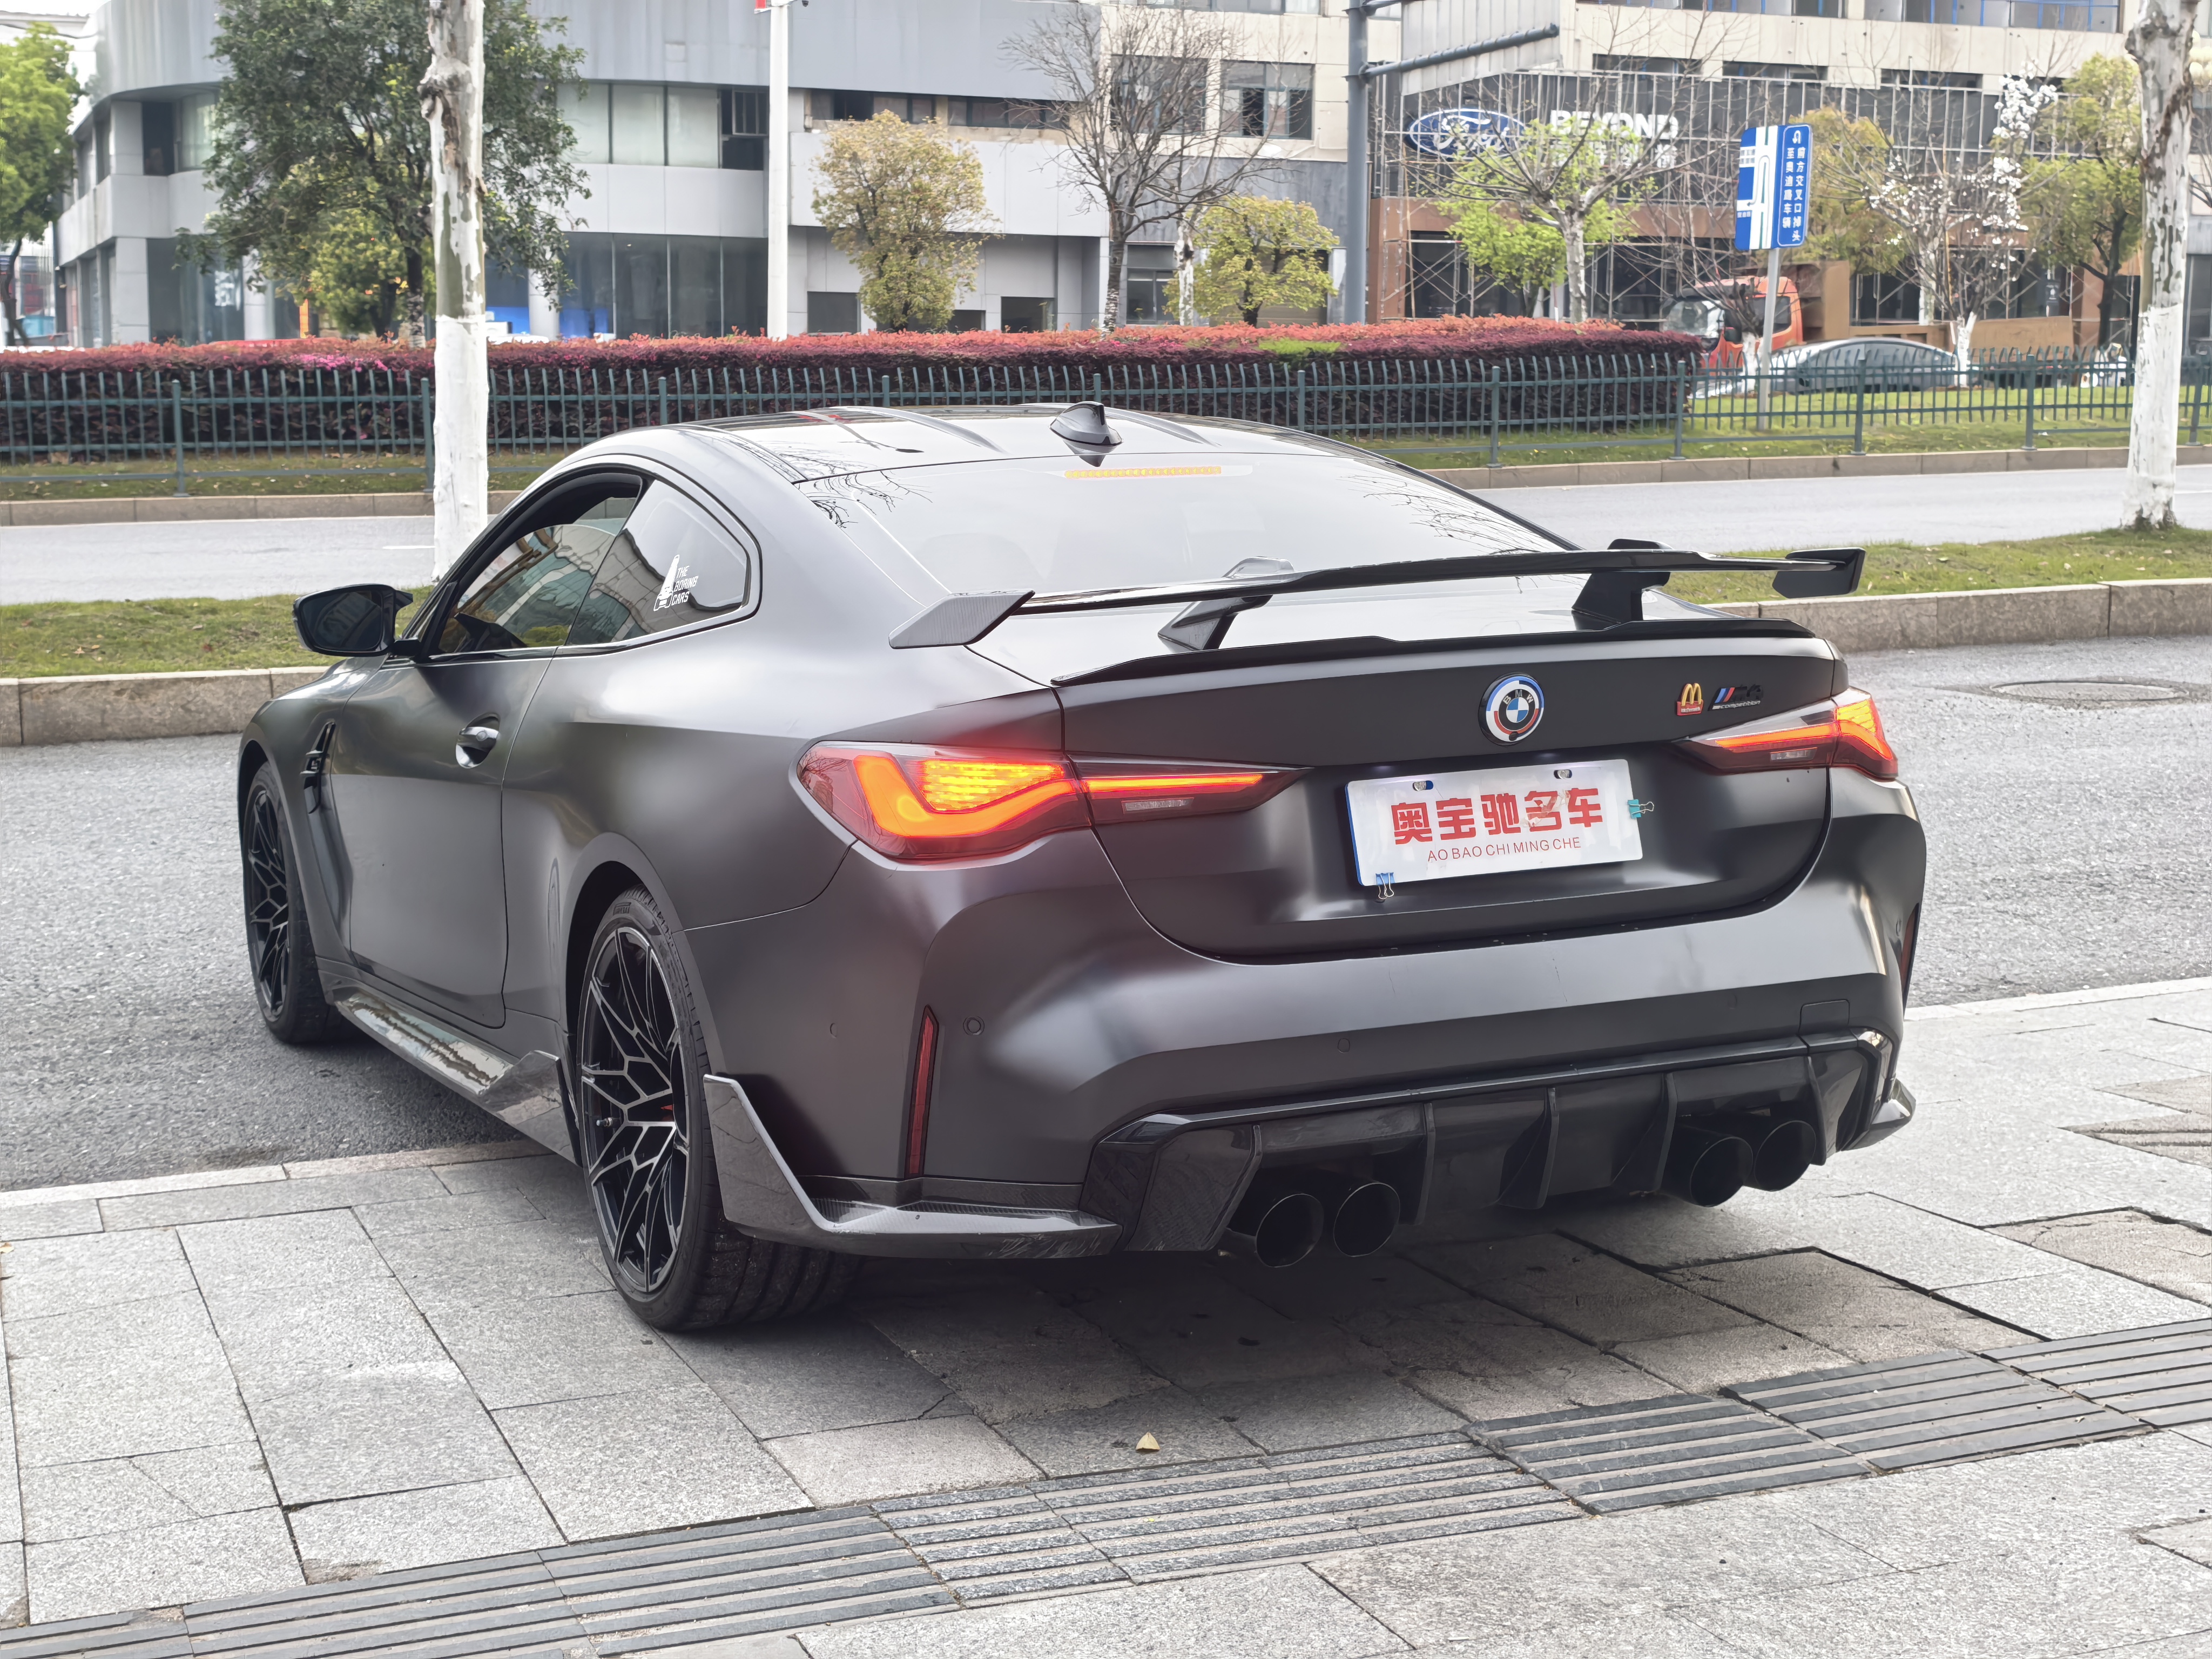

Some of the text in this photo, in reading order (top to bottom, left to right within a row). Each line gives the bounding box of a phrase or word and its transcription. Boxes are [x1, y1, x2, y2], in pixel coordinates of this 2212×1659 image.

[676, 565, 690, 579] THE
[673, 576, 699, 592] BORING
[671, 591, 690, 606] CARS
[1503, 690, 1534, 705] BMW
[1391, 787, 1603, 845] 奥宝驰名车
